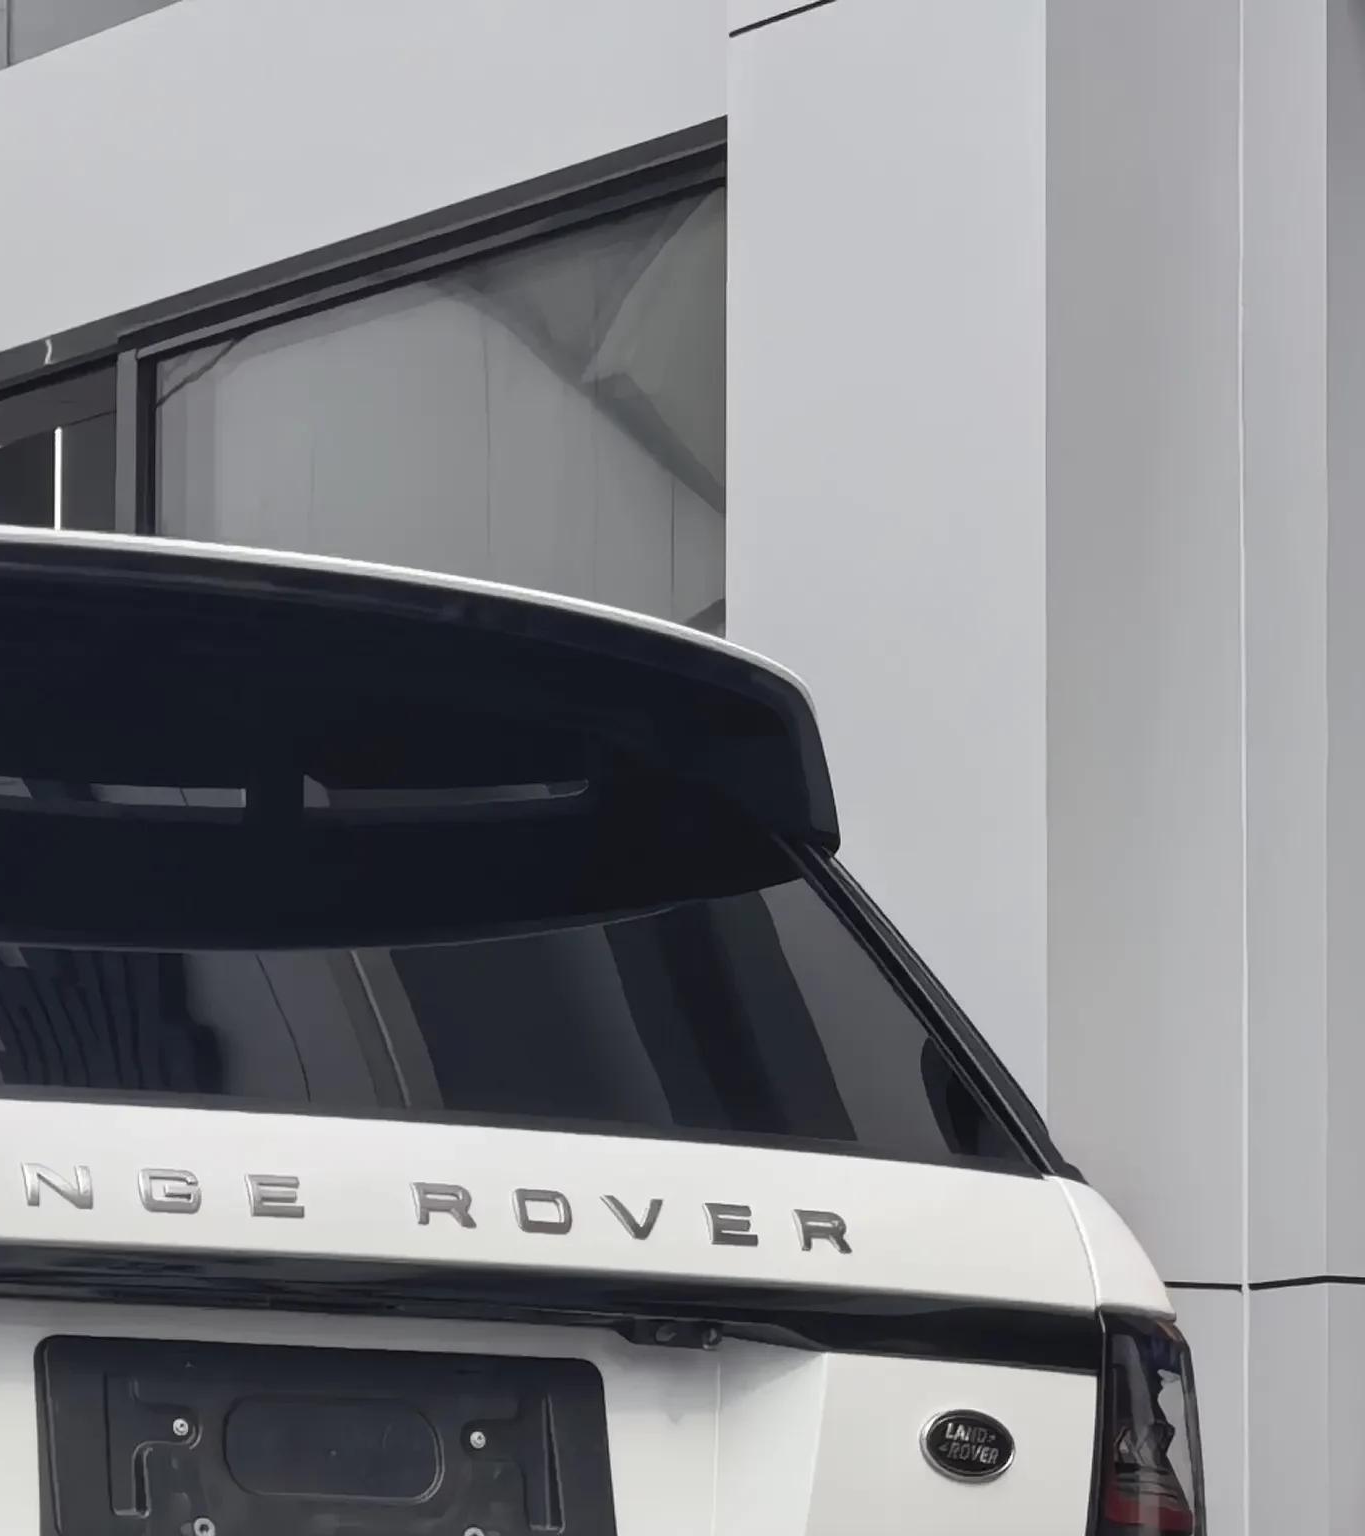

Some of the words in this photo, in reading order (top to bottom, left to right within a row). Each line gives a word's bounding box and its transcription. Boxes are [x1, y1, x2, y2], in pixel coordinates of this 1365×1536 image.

[409, 1180, 853, 1256] ROVER
[945, 1422, 988, 1443] LAND
[947, 1442, 1000, 1464] ROVER
